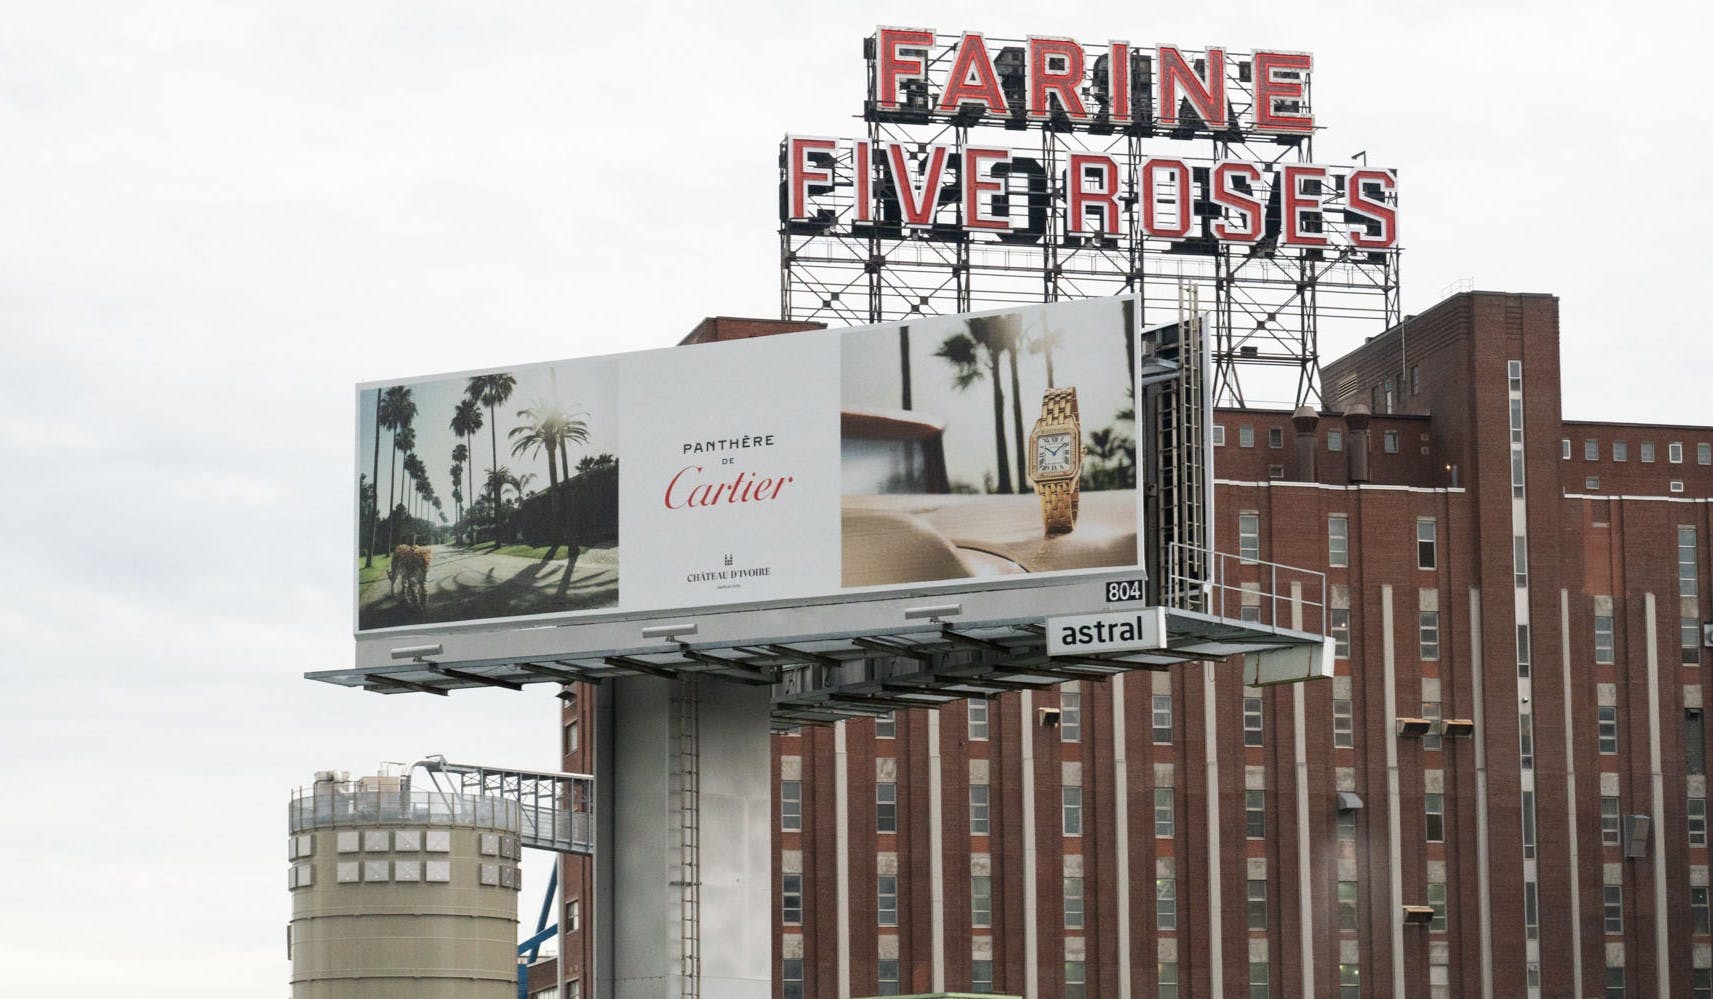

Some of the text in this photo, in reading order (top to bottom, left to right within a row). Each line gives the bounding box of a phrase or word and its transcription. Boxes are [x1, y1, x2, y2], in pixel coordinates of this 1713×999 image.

[876, 25, 1316, 135] FARINE
[788, 135, 1399, 252] FIVE ROSES
[683, 434, 775, 455] PANTHÈRE
[721, 457, 735, 465] DE
[664, 465, 794, 510] Cartier
[730, 567, 772, 579] D'IVOIRE
[1108, 581, 1141, 601] 804
[1062, 616, 1143, 646] astral
